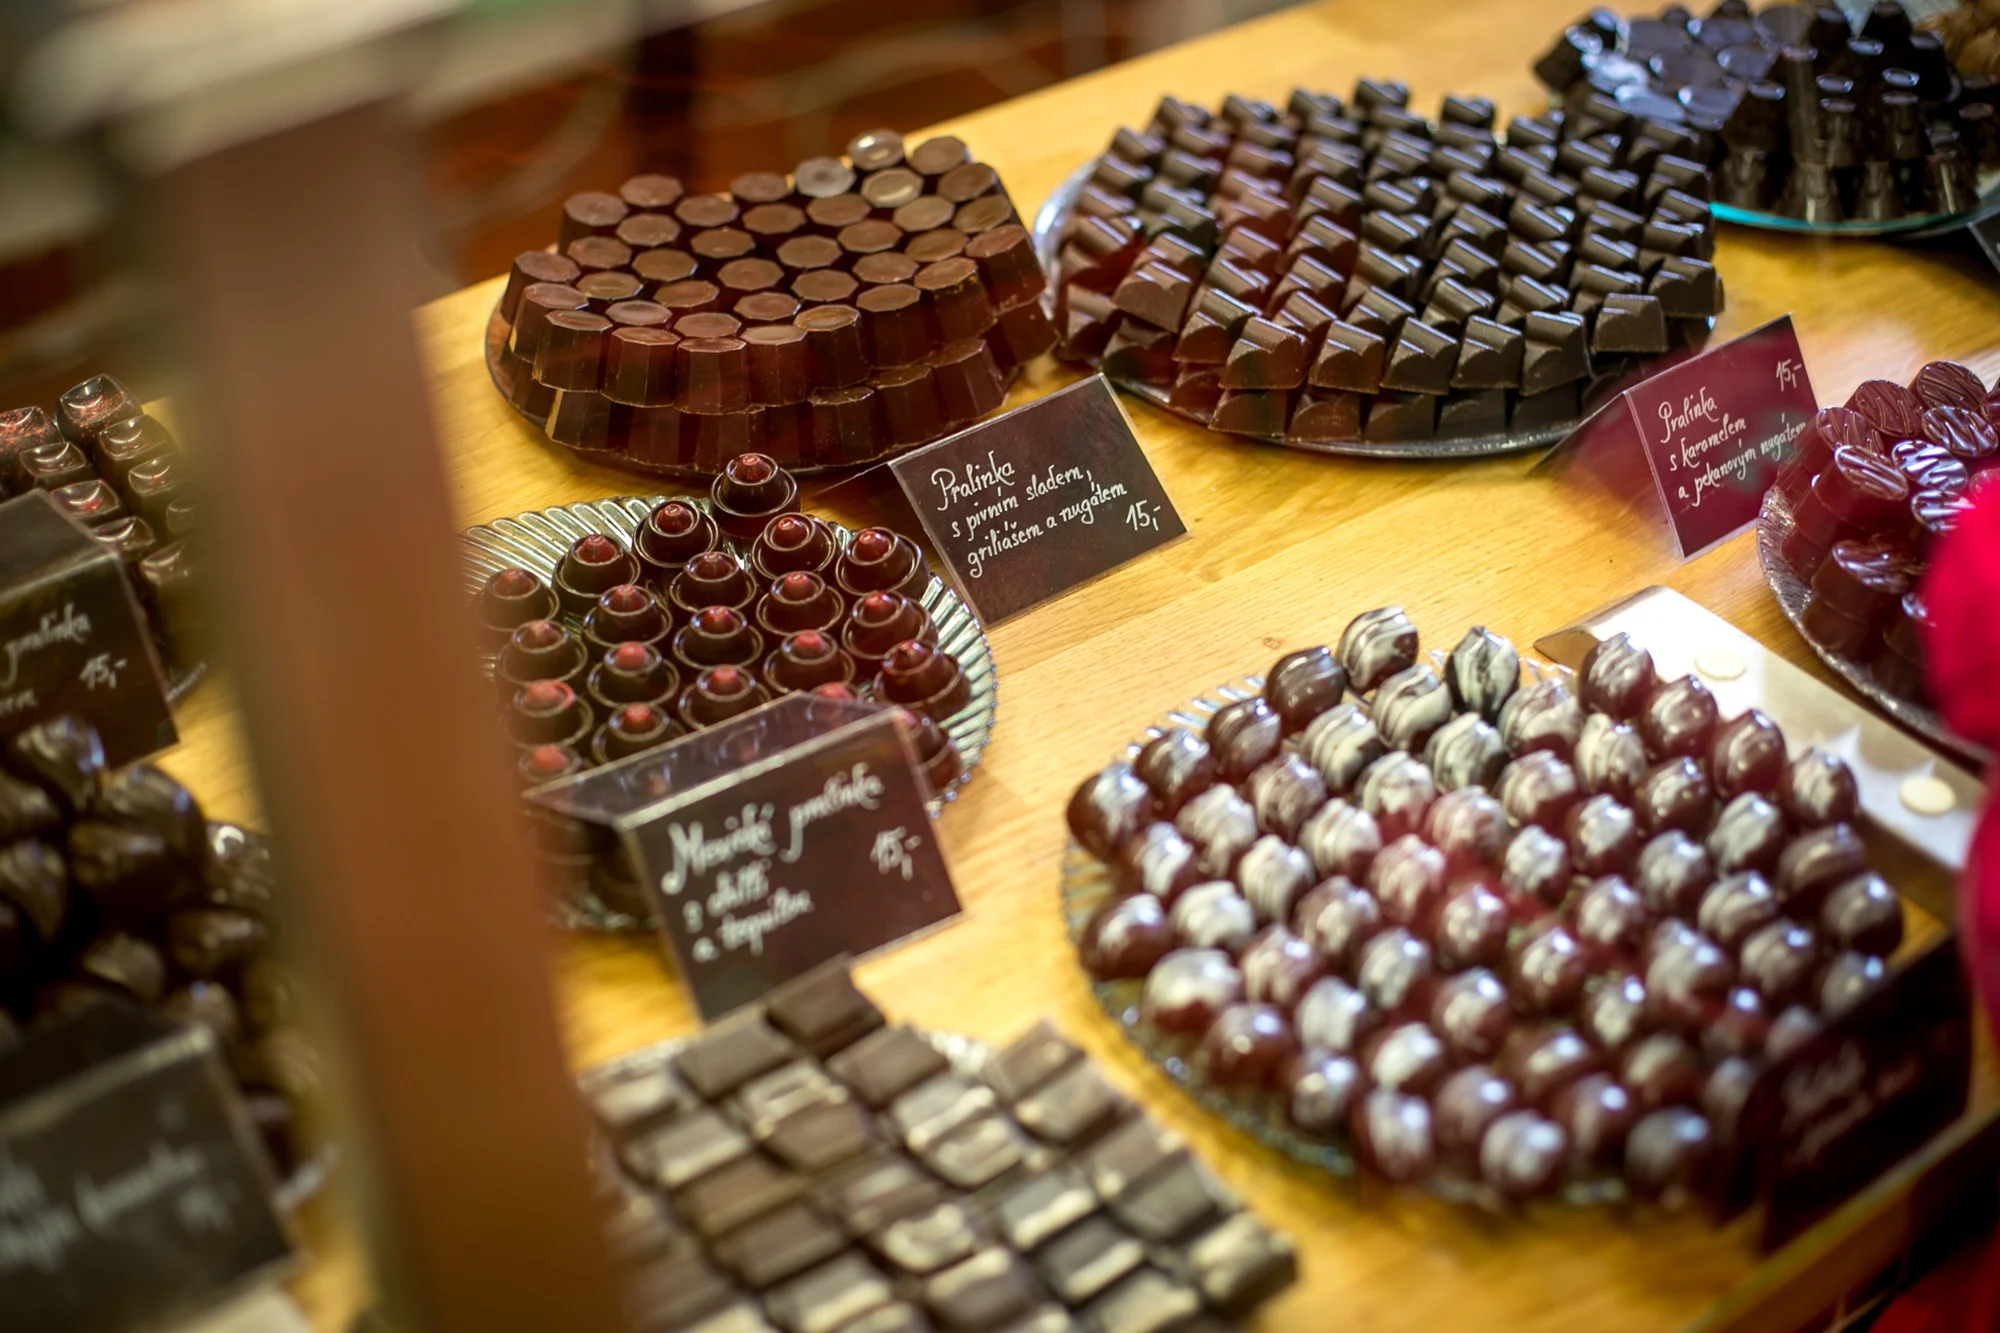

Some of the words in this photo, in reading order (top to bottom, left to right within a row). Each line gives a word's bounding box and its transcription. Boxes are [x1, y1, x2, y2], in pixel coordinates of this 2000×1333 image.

[1658, 386, 1719, 443] Pralinka
[1670, 452, 1678, 471] s
[1681, 413, 1747, 469] karamelem
[931, 450, 1015, 511] Pralinka
[1678, 485, 1690, 499] a
[1692, 438, 1757, 507] pekanovým
[1760, 412, 1806, 462] nugátem
[951, 520, 961, 538] s
[966, 486, 1019, 541] pivním
[1026, 464, 1093, 501] sladem,
[967, 520, 1044, 578] griliášem
[1046, 516, 1058, 528] a
[1059, 481, 1128, 524] nugátem
